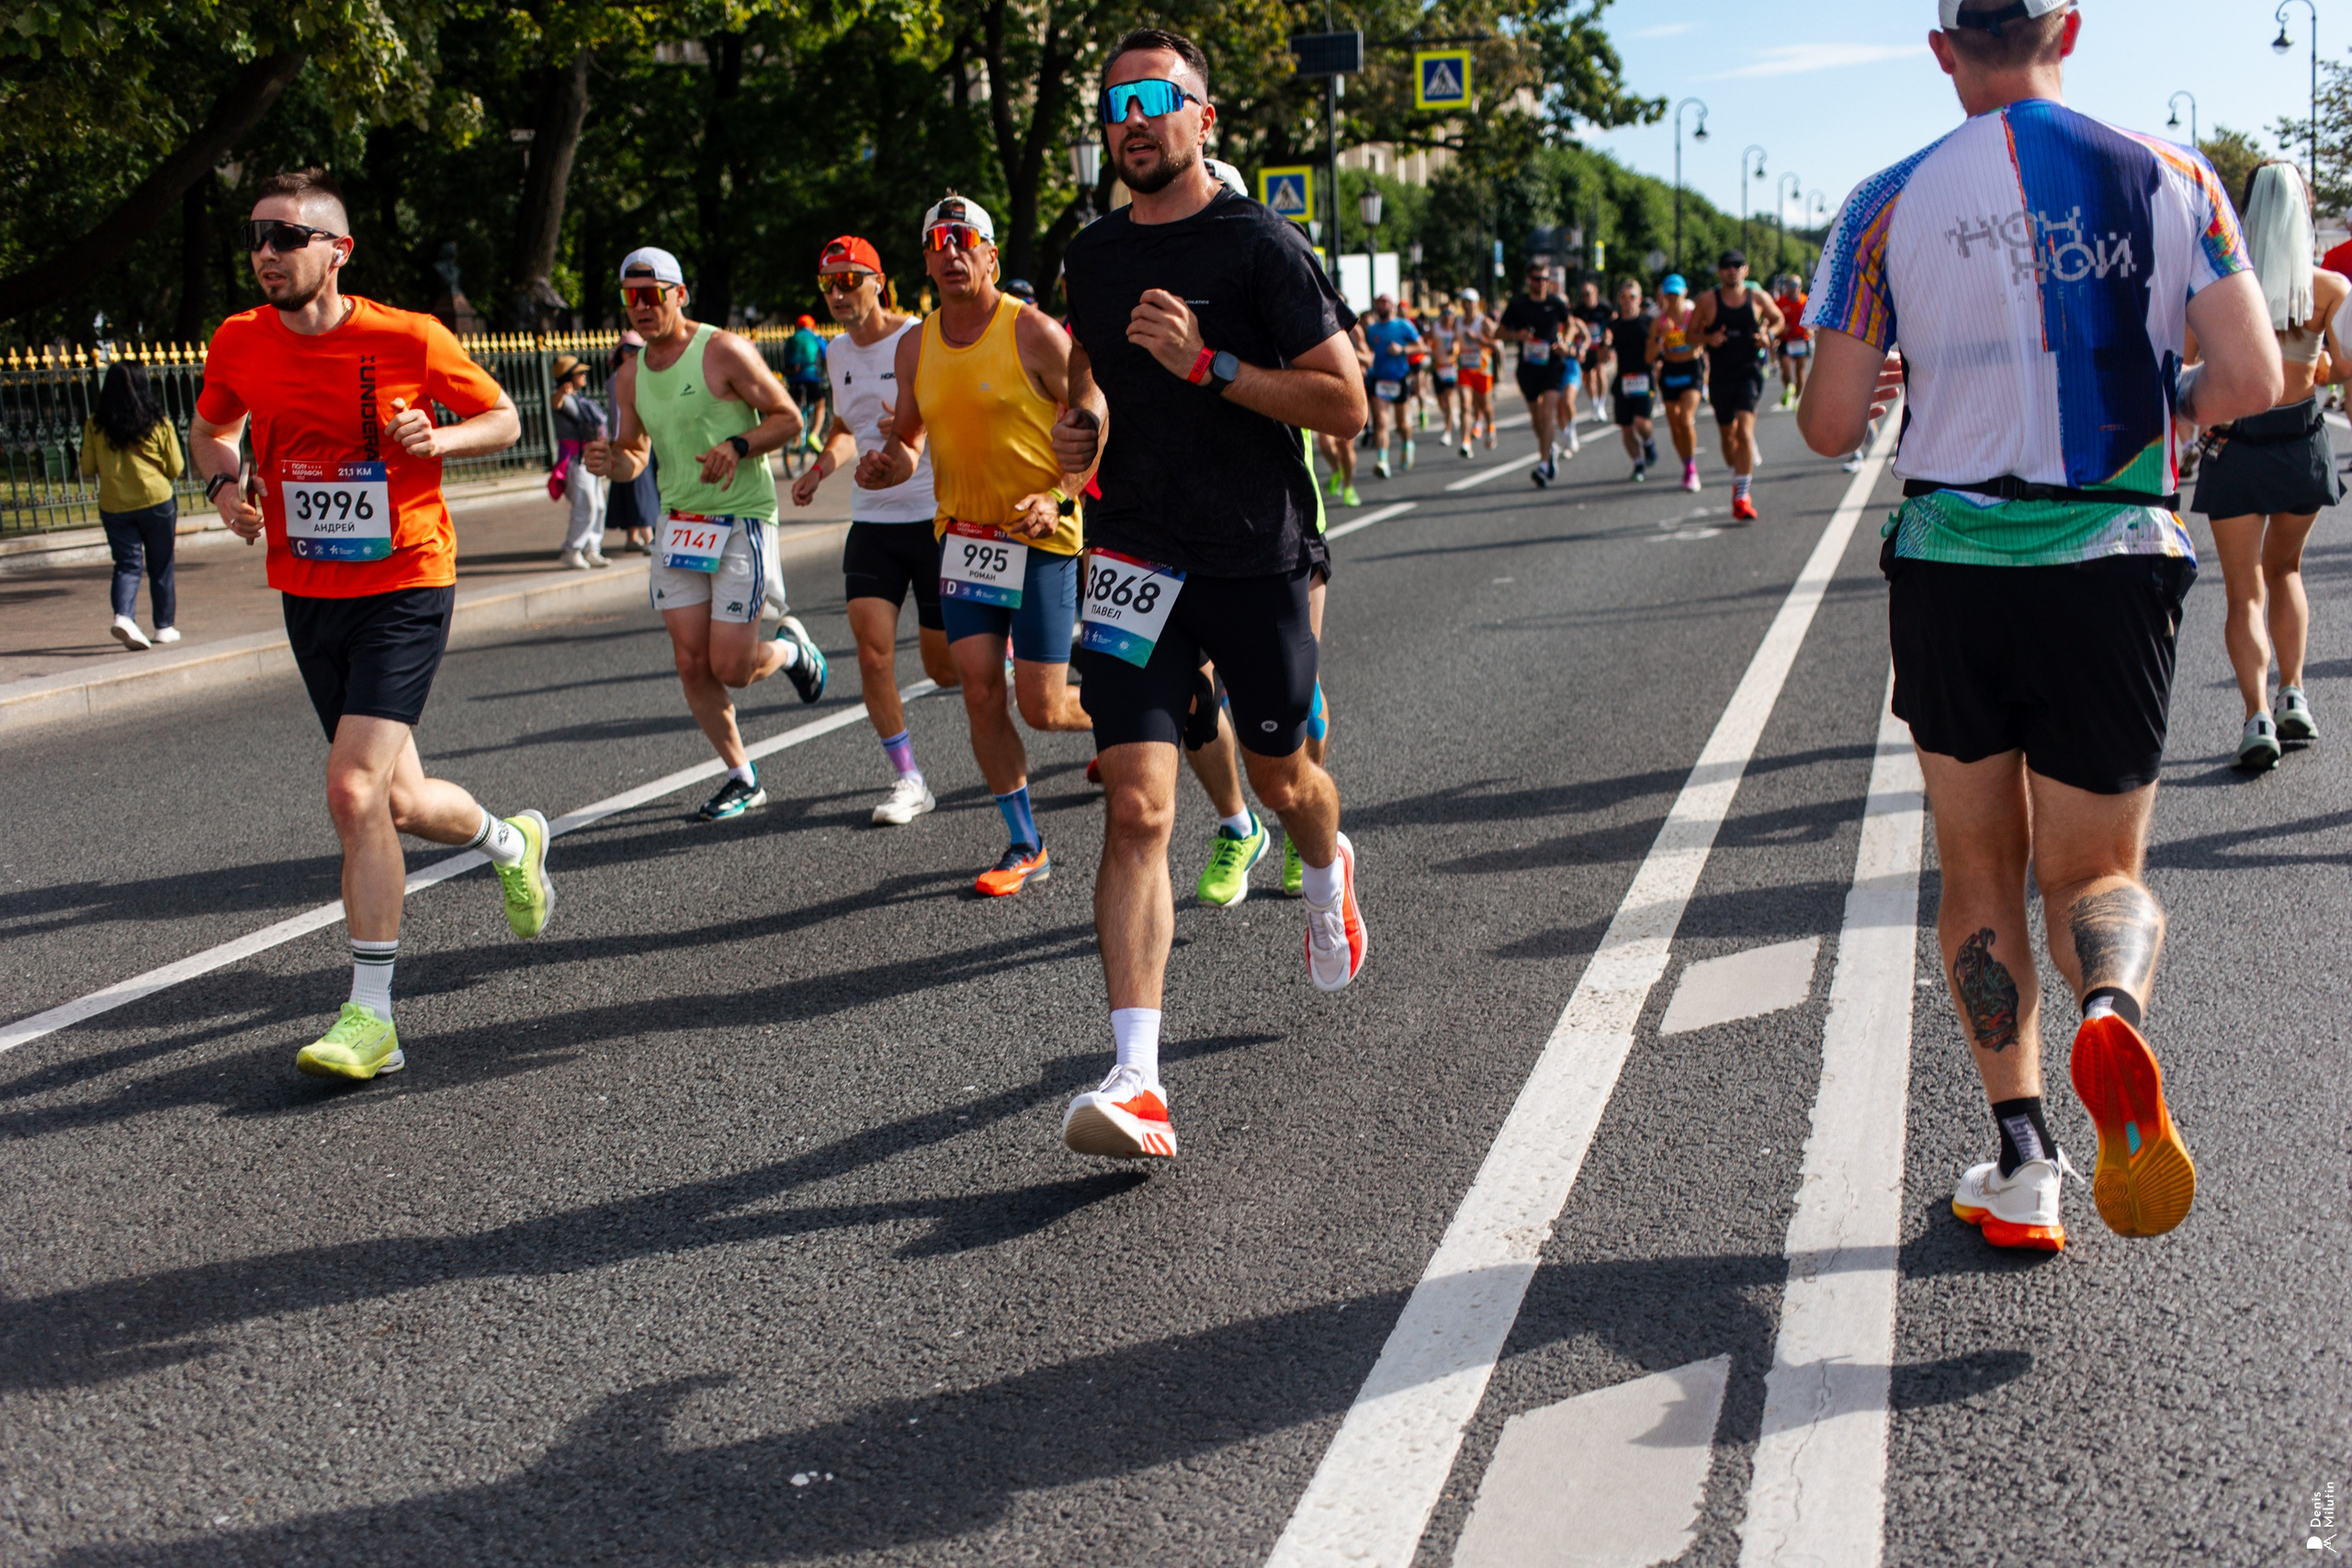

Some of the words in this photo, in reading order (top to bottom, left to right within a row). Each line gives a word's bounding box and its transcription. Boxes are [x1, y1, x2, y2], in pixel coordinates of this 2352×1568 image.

[338, 468, 355, 477] 21,1
[295, 490, 374, 520] 3996
[313, 522, 356, 534] АНДРЕЙ
[671, 529, 718, 550] 7141
[963, 544, 1009, 572] 995
[969, 570, 997, 581] РОМАН
[946, 581, 957, 595] D
[1086, 564, 1161, 615] 3868
[1091, 604, 1123, 621] ПАВЕЛ
